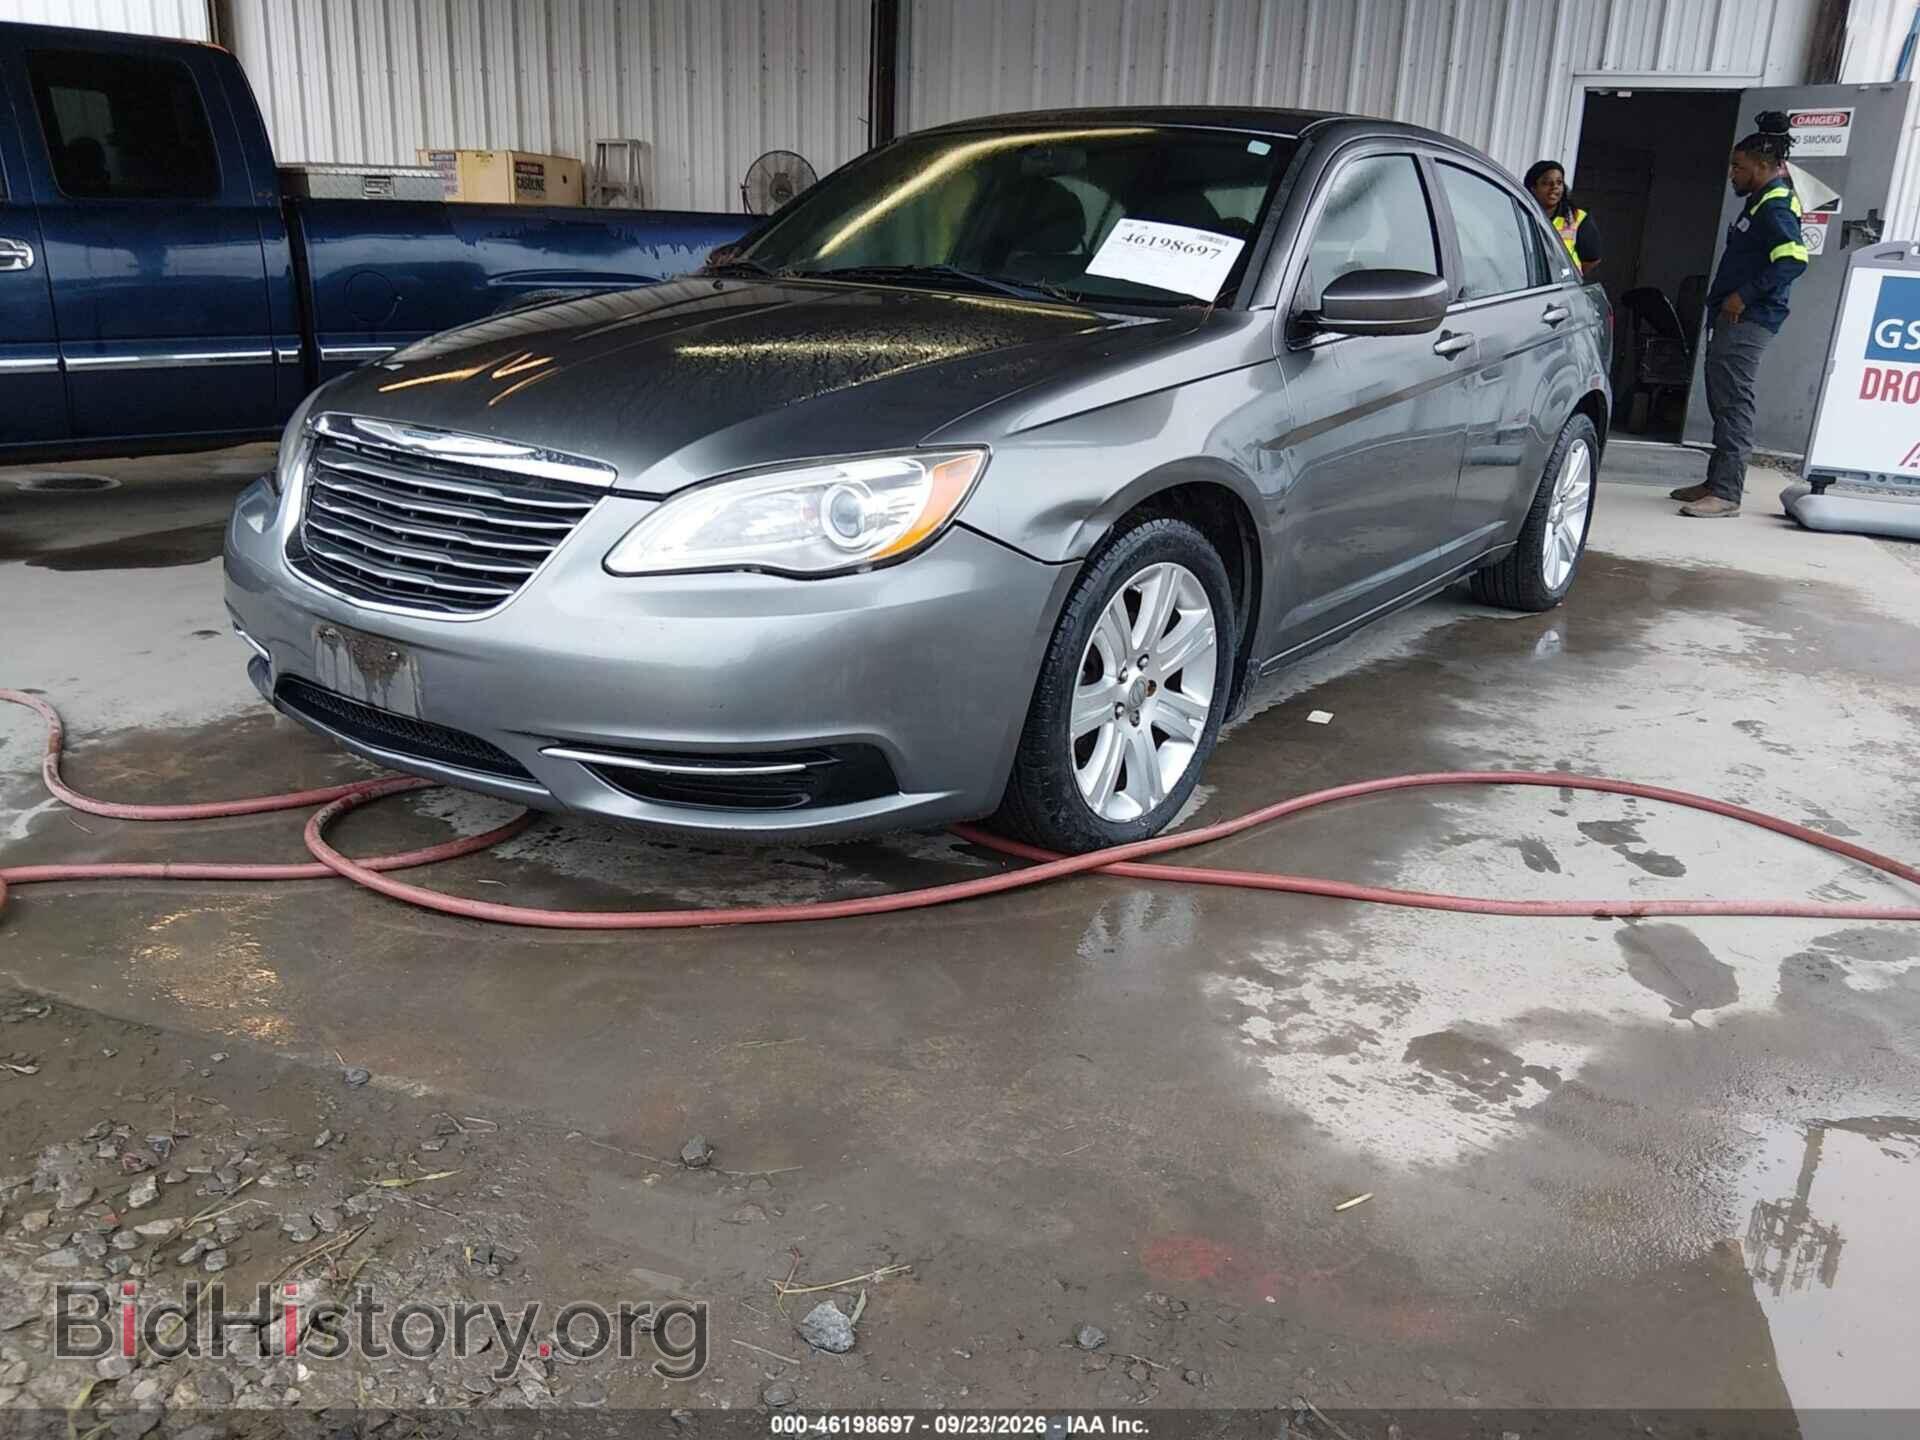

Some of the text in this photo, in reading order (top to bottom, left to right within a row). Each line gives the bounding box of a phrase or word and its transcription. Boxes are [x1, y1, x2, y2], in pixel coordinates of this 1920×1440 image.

[1796, 115, 1841, 125] DANGER
[1803, 134, 1843, 145] SMOKING
[1121, 232, 1222, 260] 46198697
